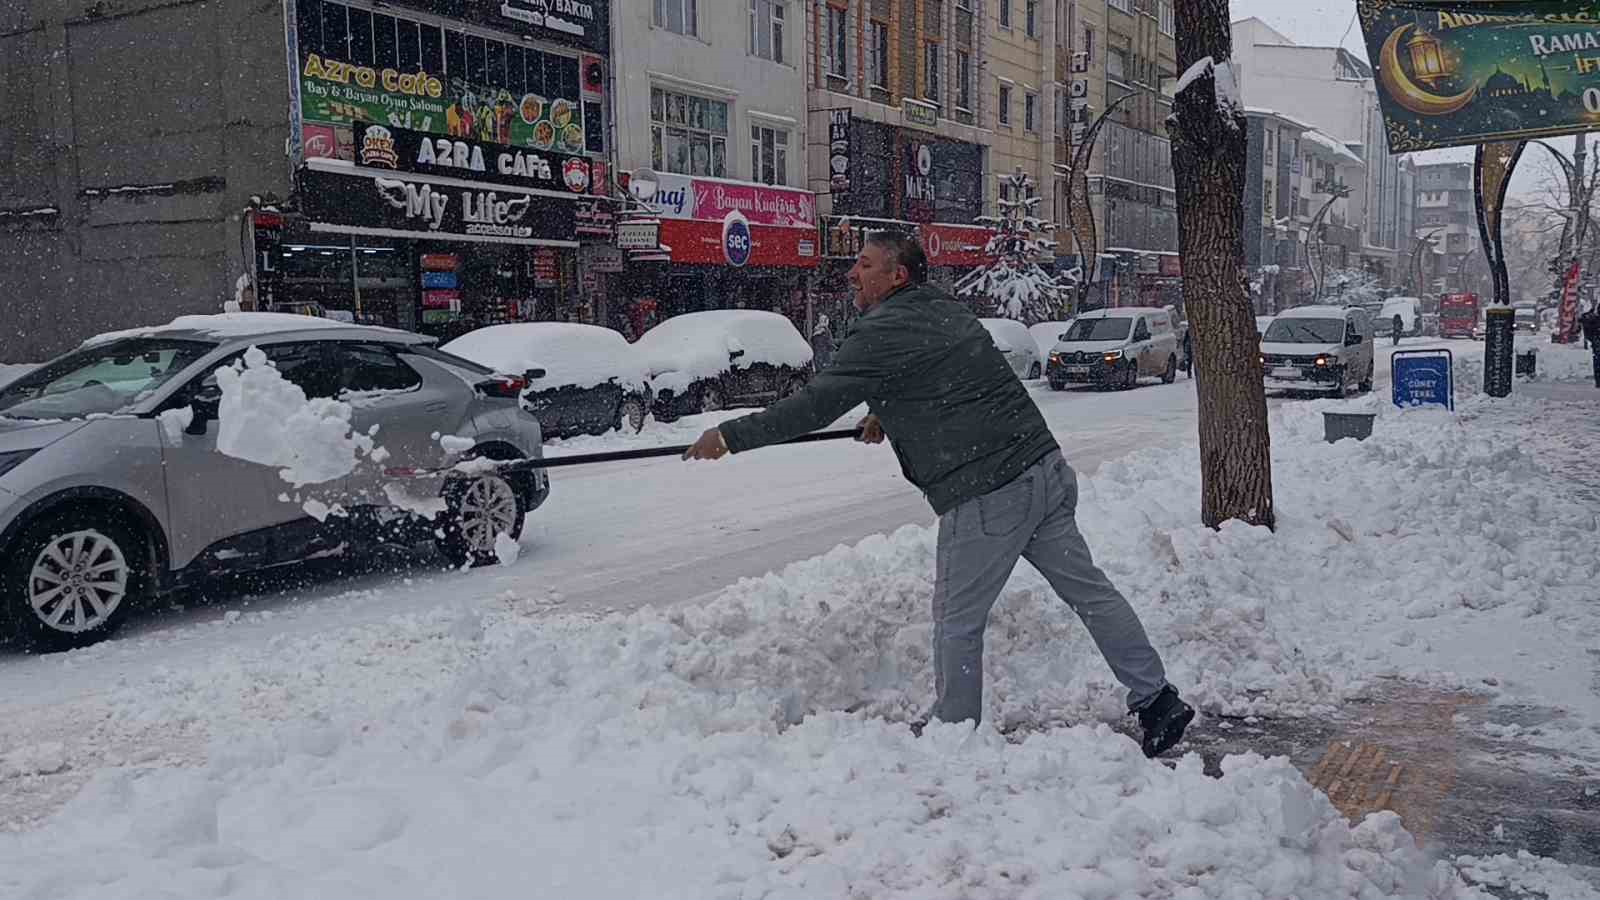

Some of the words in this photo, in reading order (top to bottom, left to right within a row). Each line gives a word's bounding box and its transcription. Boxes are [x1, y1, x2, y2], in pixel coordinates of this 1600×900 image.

[304, 53, 376, 88] Azra
[304, 80, 329, 97] Bay
[343, 87, 379, 105] Bayan
[380, 94, 412, 110] Oyun
[417, 136, 486, 172] AZRA
[406, 183, 448, 229] My
[462, 191, 510, 224] Life
